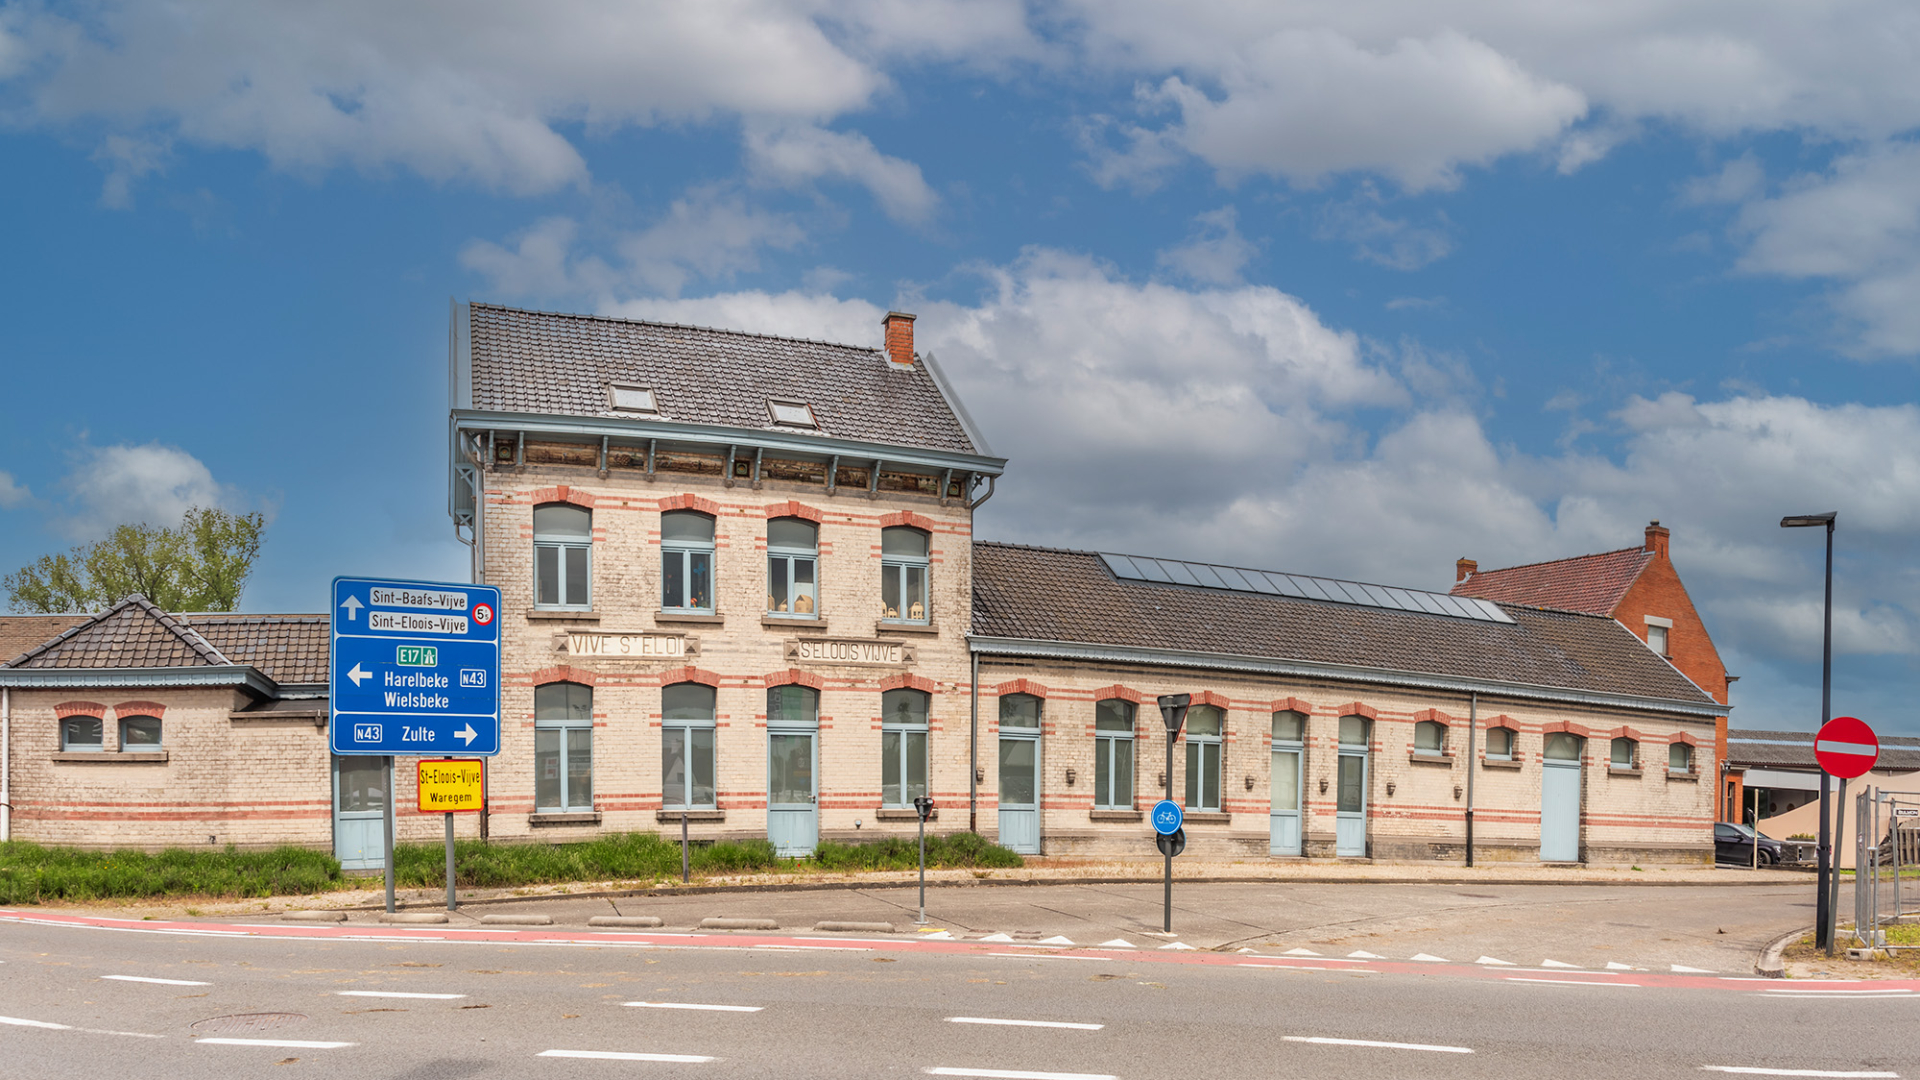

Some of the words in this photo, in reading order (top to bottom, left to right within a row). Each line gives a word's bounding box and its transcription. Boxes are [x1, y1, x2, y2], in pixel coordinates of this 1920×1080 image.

[372, 590, 466, 610] Sint-Baafs-Vijve
[371, 614, 466, 634] Sint-Eloois-Vijve
[571, 635, 612, 654] VIVE
[642, 636, 682, 655] ELOI
[862, 643, 898, 662] VIJVE
[400, 649, 420, 663] E17
[384, 671, 449, 688] Harelbeke
[462, 672, 484, 685] N43
[384, 691, 449, 708] Wielsbeke
[356, 726, 380, 740] N43
[401, 726, 436, 742] Zulte
[420, 769, 480, 787] St-Eloois-Vijve
[430, 793, 472, 804] Waregem
